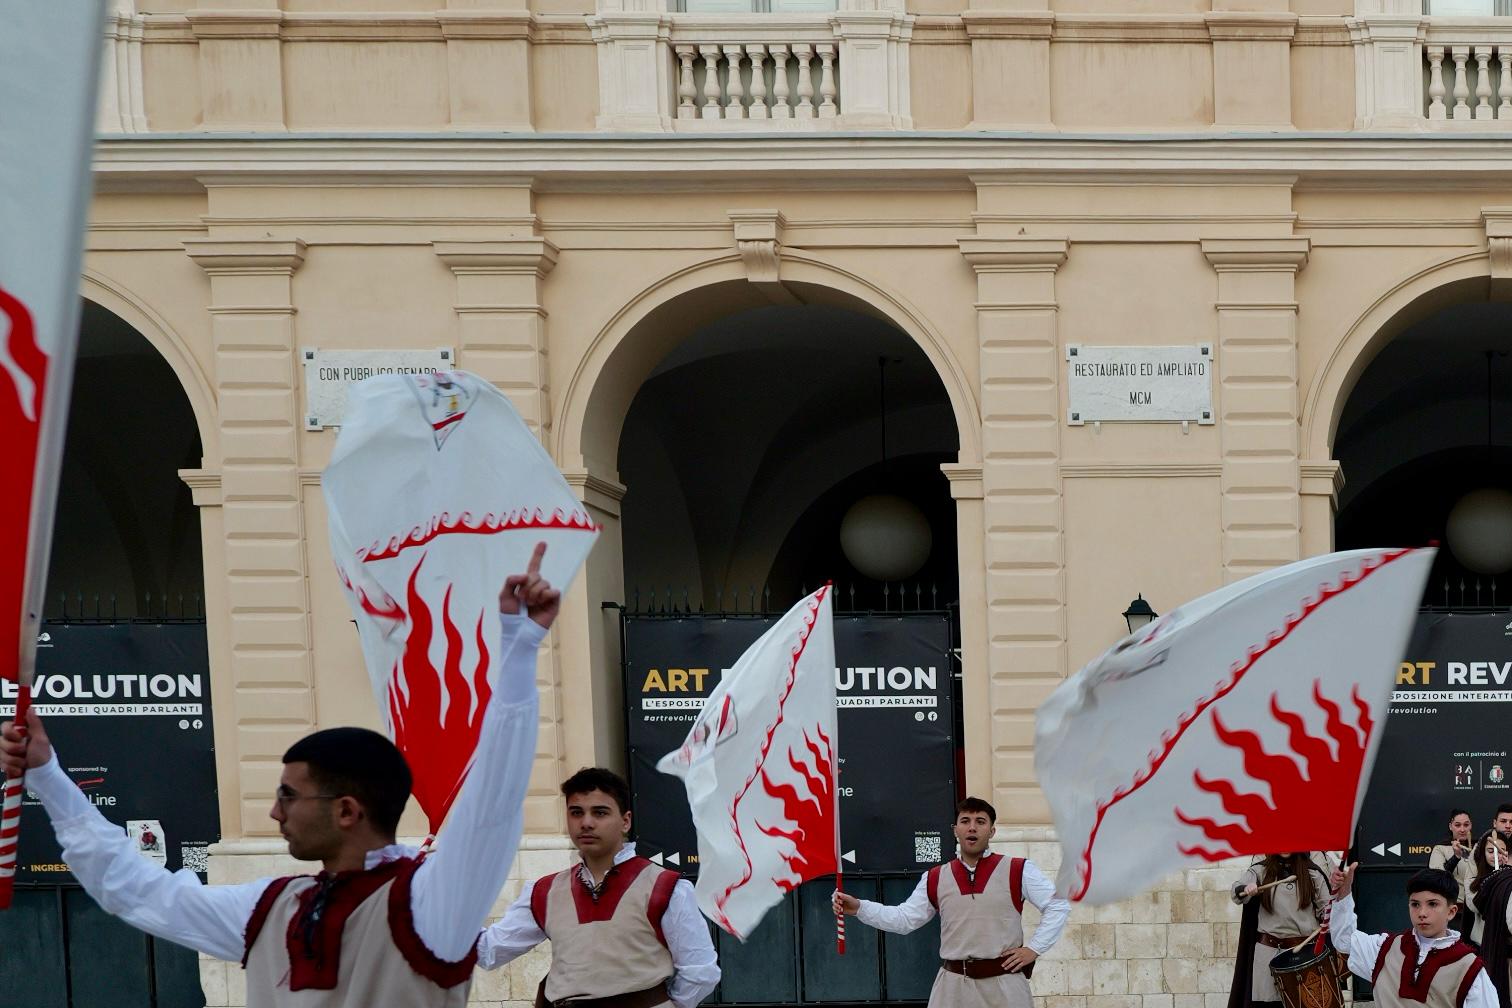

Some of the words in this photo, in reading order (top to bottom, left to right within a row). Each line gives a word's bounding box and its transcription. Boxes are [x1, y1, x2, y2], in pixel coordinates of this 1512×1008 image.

[319, 367, 340, 381] CON
[1075, 363, 1136, 377] RESTAURATO
[1140, 363, 1153, 376] ED
[1157, 362, 1205, 376] AMPLIATO
[1129, 391, 1152, 405] MCM
[1395, 661, 1436, 685] RT
[641, 668, 709, 692] ART
[834, 666, 937, 691] UTION
[1, 674, 202, 699] EVOLUTION
[1390, 692, 1454, 700] SPOSIZIONE
[645, 700, 705, 708] L'ESPOSIZI
[94, 706, 138, 714] QUADRI
[143, 705, 200, 713] PARLANTI
[644, 714, 698, 722] #artrevolut
[100, 766, 108, 774] by
[837, 787, 854, 797] ne
[1408, 846, 1432, 854] INFO
[31, 864, 72, 872] INGRESS
